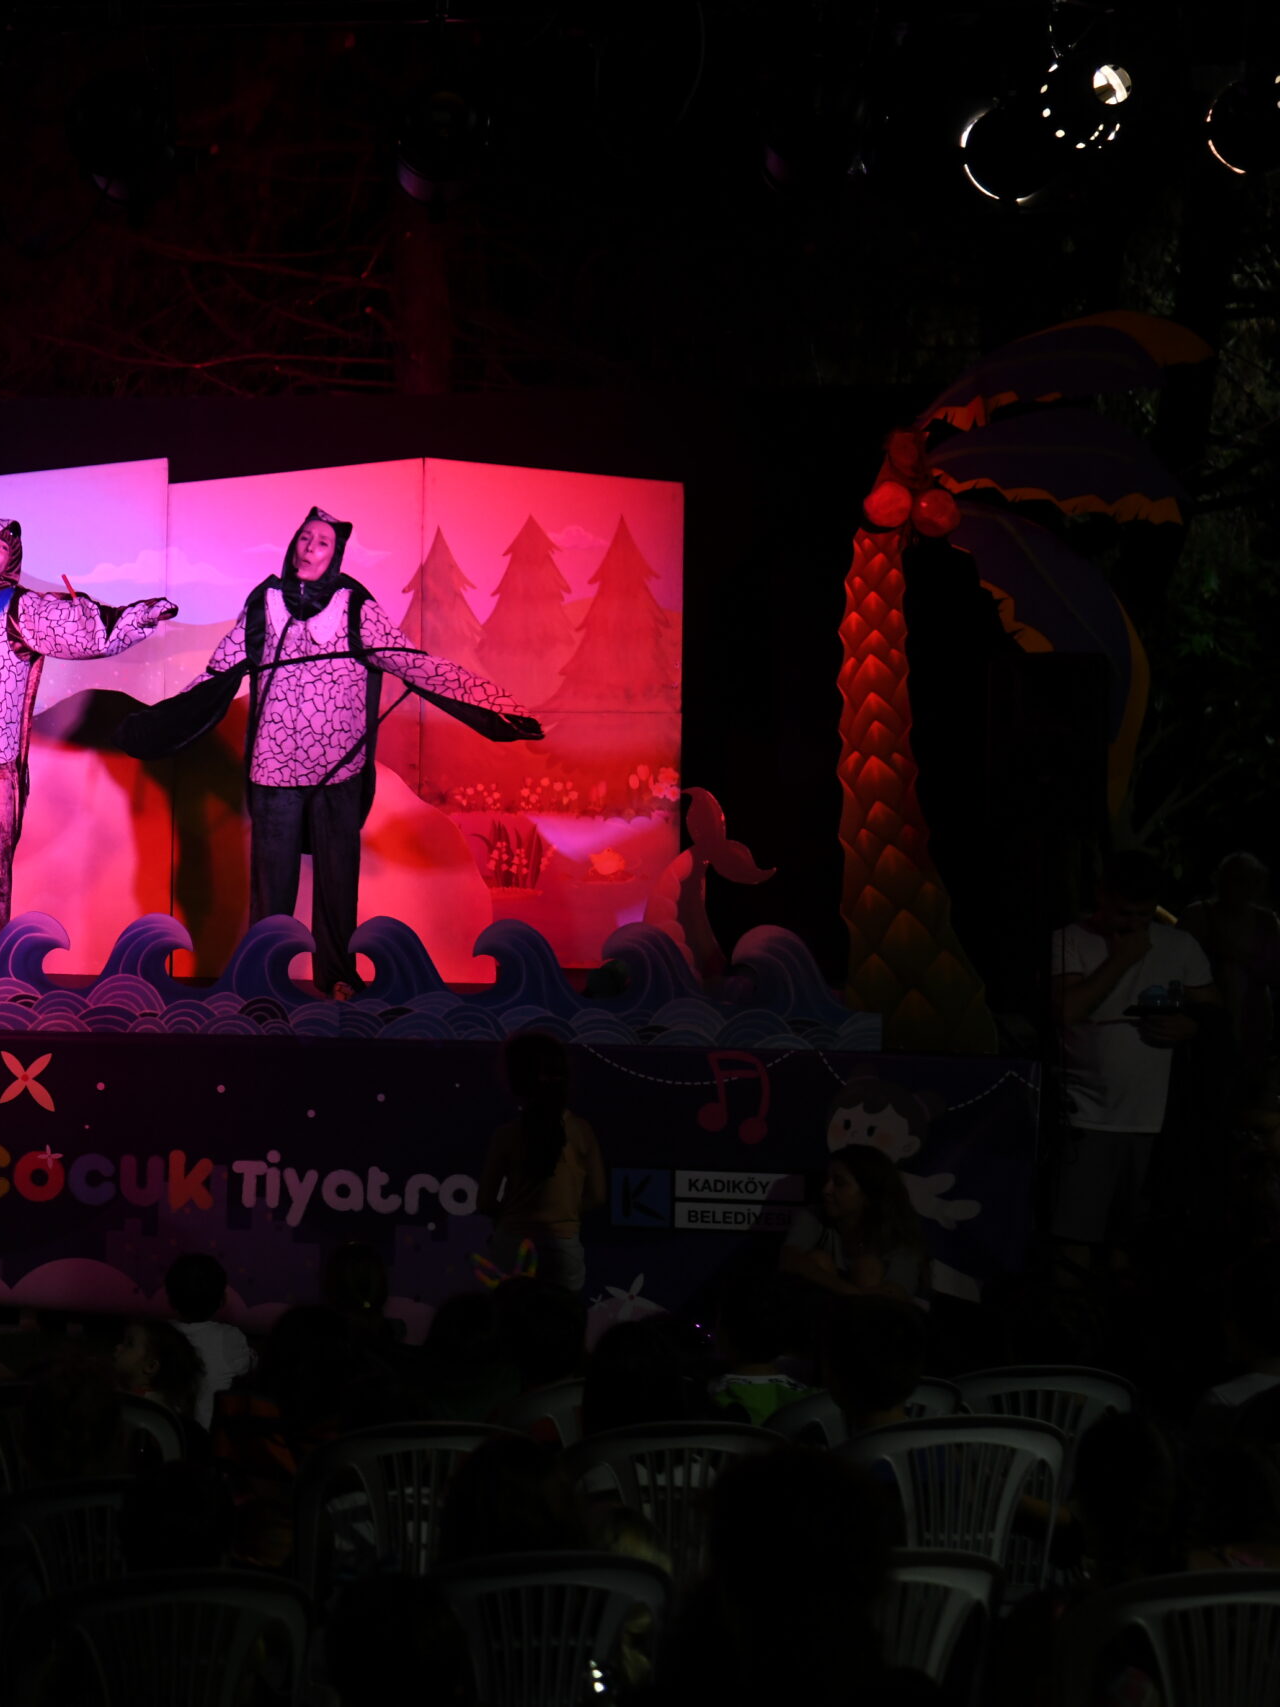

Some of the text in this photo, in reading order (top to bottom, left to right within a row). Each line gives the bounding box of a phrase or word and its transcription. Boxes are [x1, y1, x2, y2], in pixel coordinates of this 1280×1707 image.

[231, 1149, 508, 1228] Tiyatro
[687, 1176, 770, 1195] KADIKÖY
[687, 1207, 792, 1227] BELEDİYESİ
